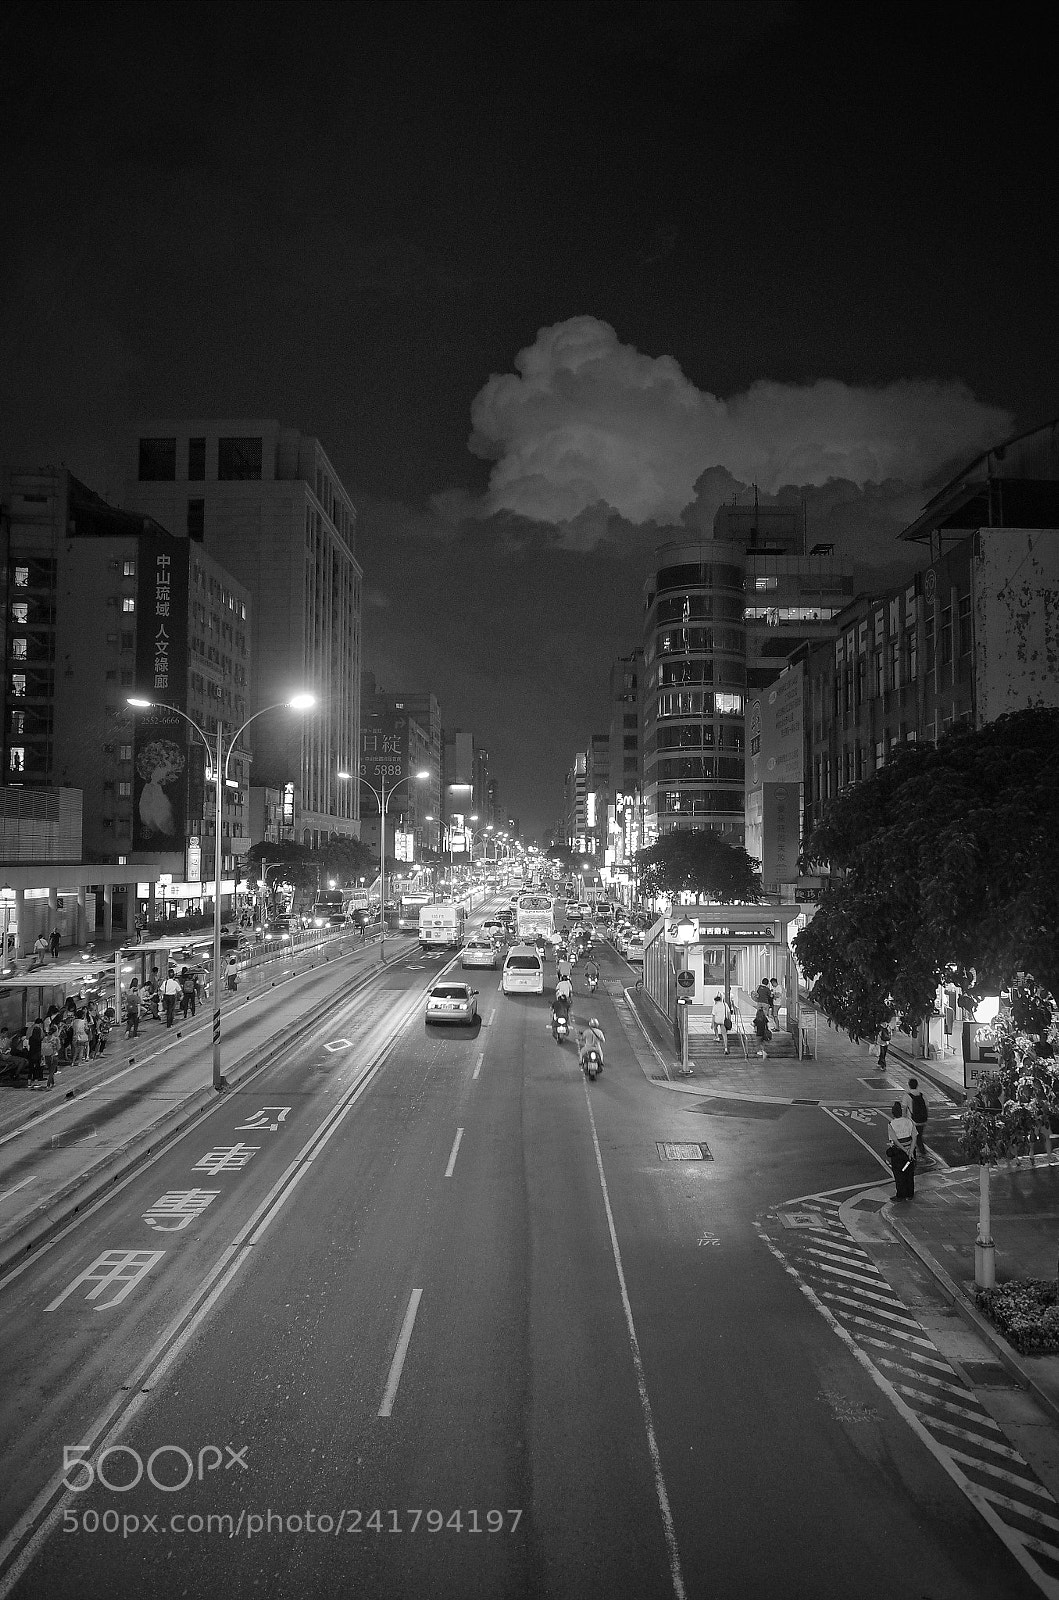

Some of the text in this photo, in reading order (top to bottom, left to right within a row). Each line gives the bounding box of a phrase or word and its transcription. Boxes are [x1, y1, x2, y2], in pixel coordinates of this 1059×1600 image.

[155, 553, 171, 617] 中山琉域
[153, 623, 170, 689] 人文綠廊
[141, 716, 181, 725] 2552-6666
[373, 764, 402, 776] 5888
